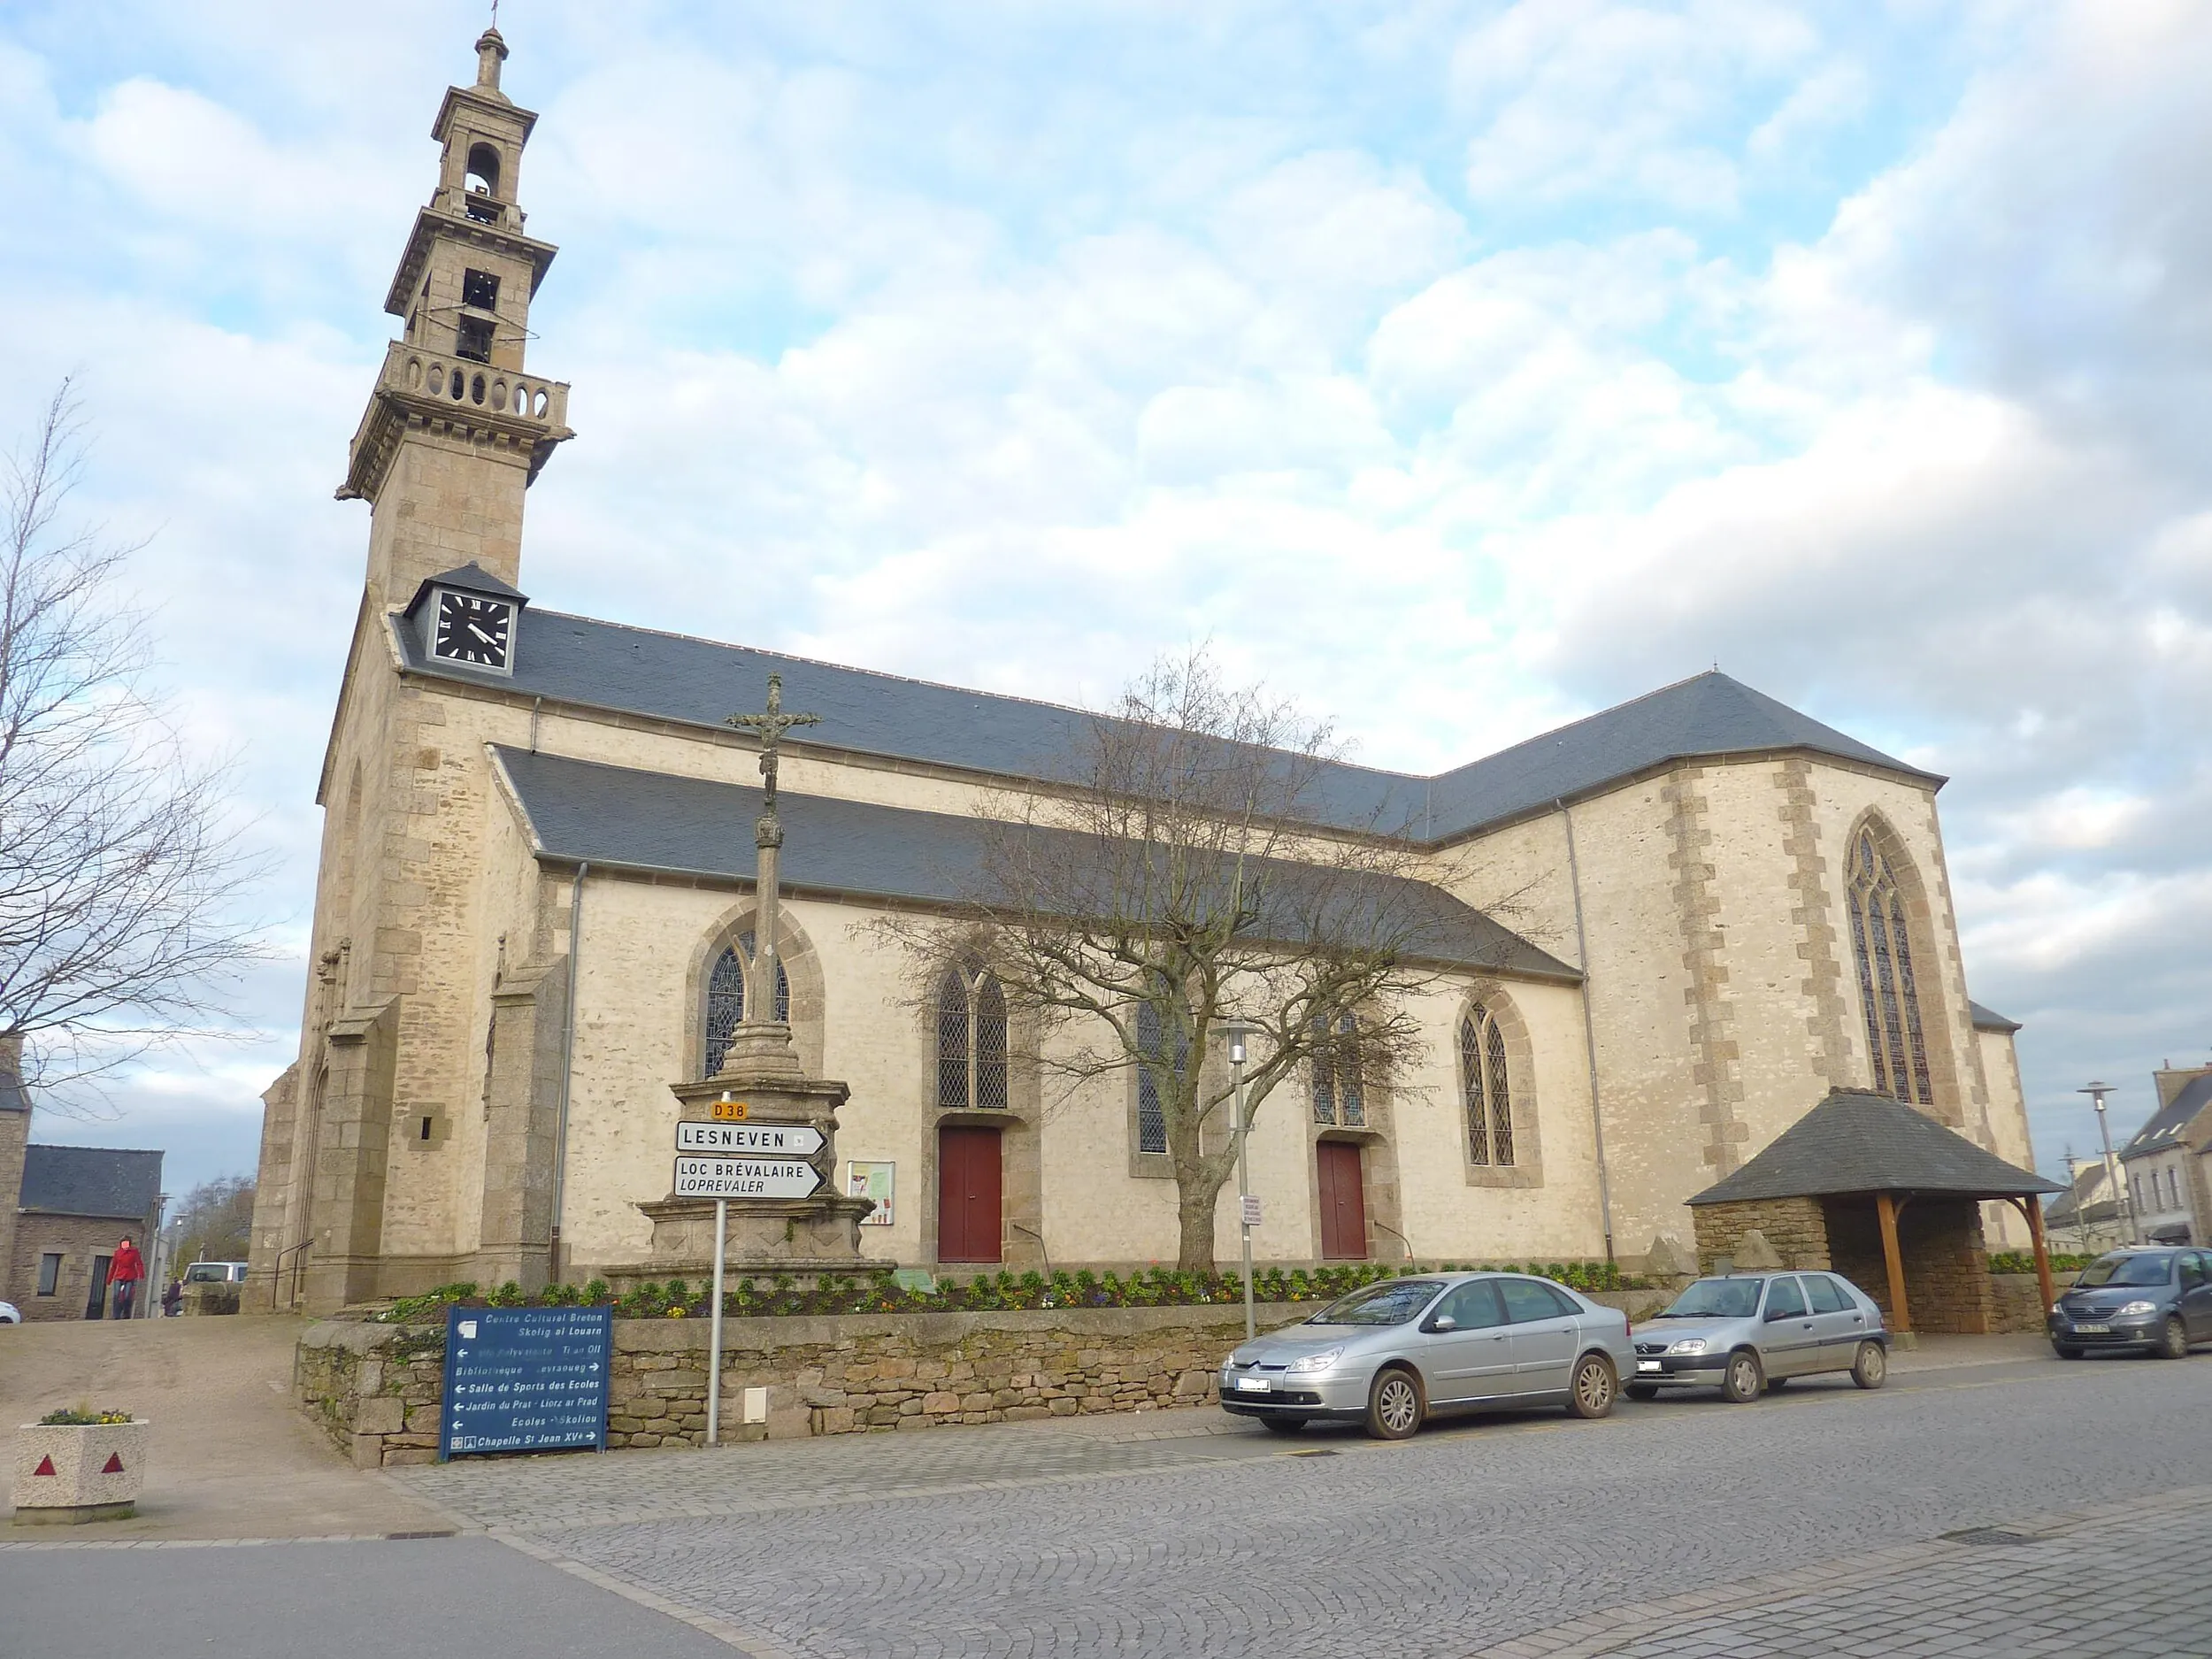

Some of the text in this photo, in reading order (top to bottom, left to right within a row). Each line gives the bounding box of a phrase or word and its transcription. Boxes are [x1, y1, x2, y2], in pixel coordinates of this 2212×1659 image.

[714, 1105, 744, 1117] D 38
[683, 1129, 784, 1147] LESNEVEN
[680, 1162, 804, 1178] LOC BRÉVALAIRE
[680, 1179, 764, 1193] LOPREVALER
[486, 1314, 519, 1324] Centre
[570, 1313, 603, 1323] Breton
[518, 1326, 602, 1338] Skolig al Louarn
[588, 1344, 601, 1355] Oll
[536, 1363, 587, 1374] evraoueg
[468, 1379, 600, 1394] Salle de Sports des Ecoles
[465, 1402, 495, 1411] Jardin
[498, 1401, 510, 1409] du
[541, 1398, 563, 1409] Liorz
[577, 1396, 598, 1406] Prad
[511, 1417, 546, 1427] Ecoles
[559, 1415, 597, 1425] Skoliou
[478, 1434, 521, 1448] Chapelle
[525, 1434, 534, 1443] St
[537, 1432, 561, 1443] Jean
